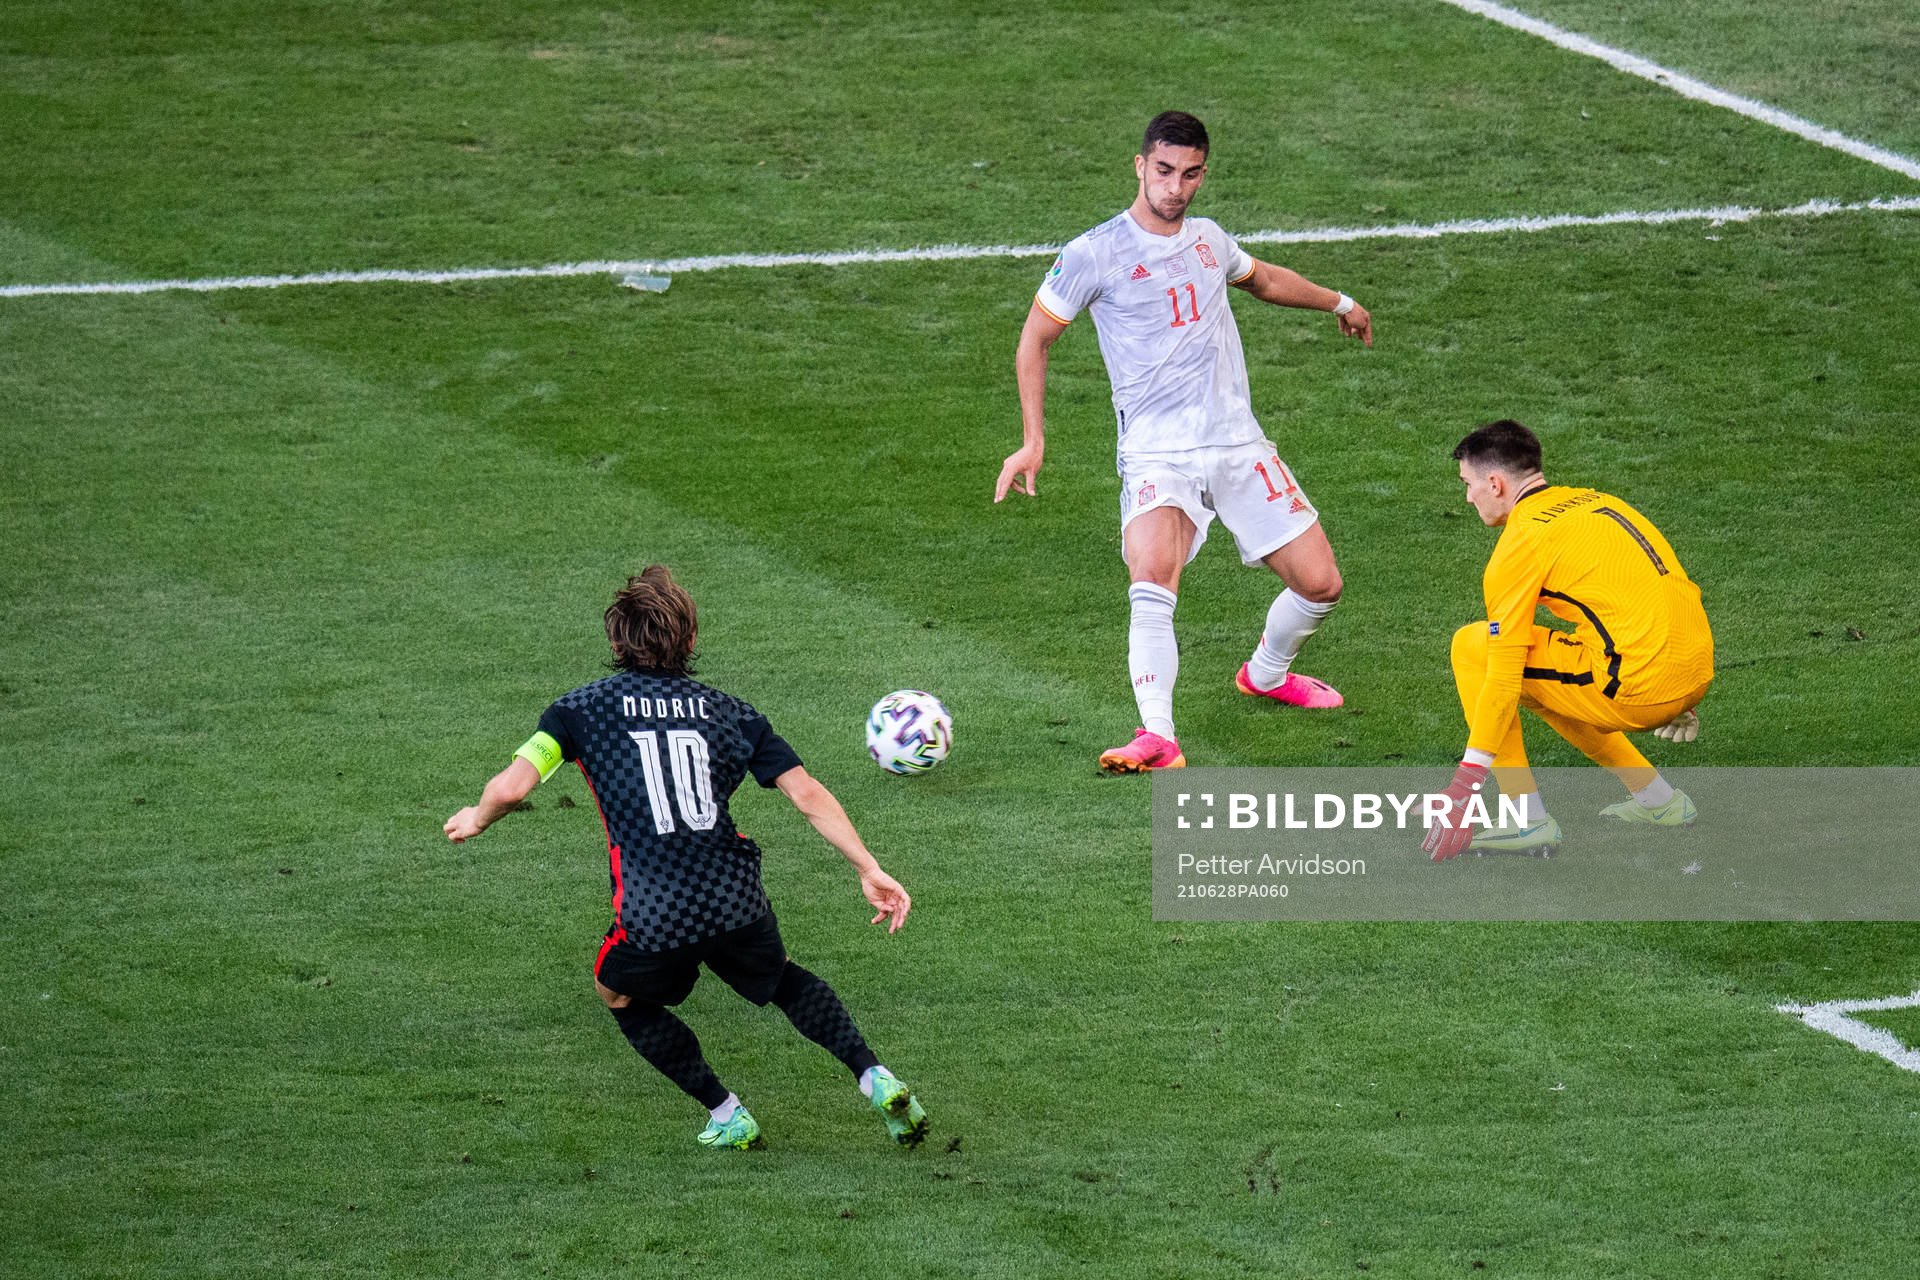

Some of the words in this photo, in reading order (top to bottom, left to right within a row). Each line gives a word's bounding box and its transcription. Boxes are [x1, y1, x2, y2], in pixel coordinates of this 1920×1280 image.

[1167, 283, 1201, 327] 11
[1254, 455, 1297, 502] 11
[1591, 506, 1670, 576] 1
[627, 729, 717, 835] 10
